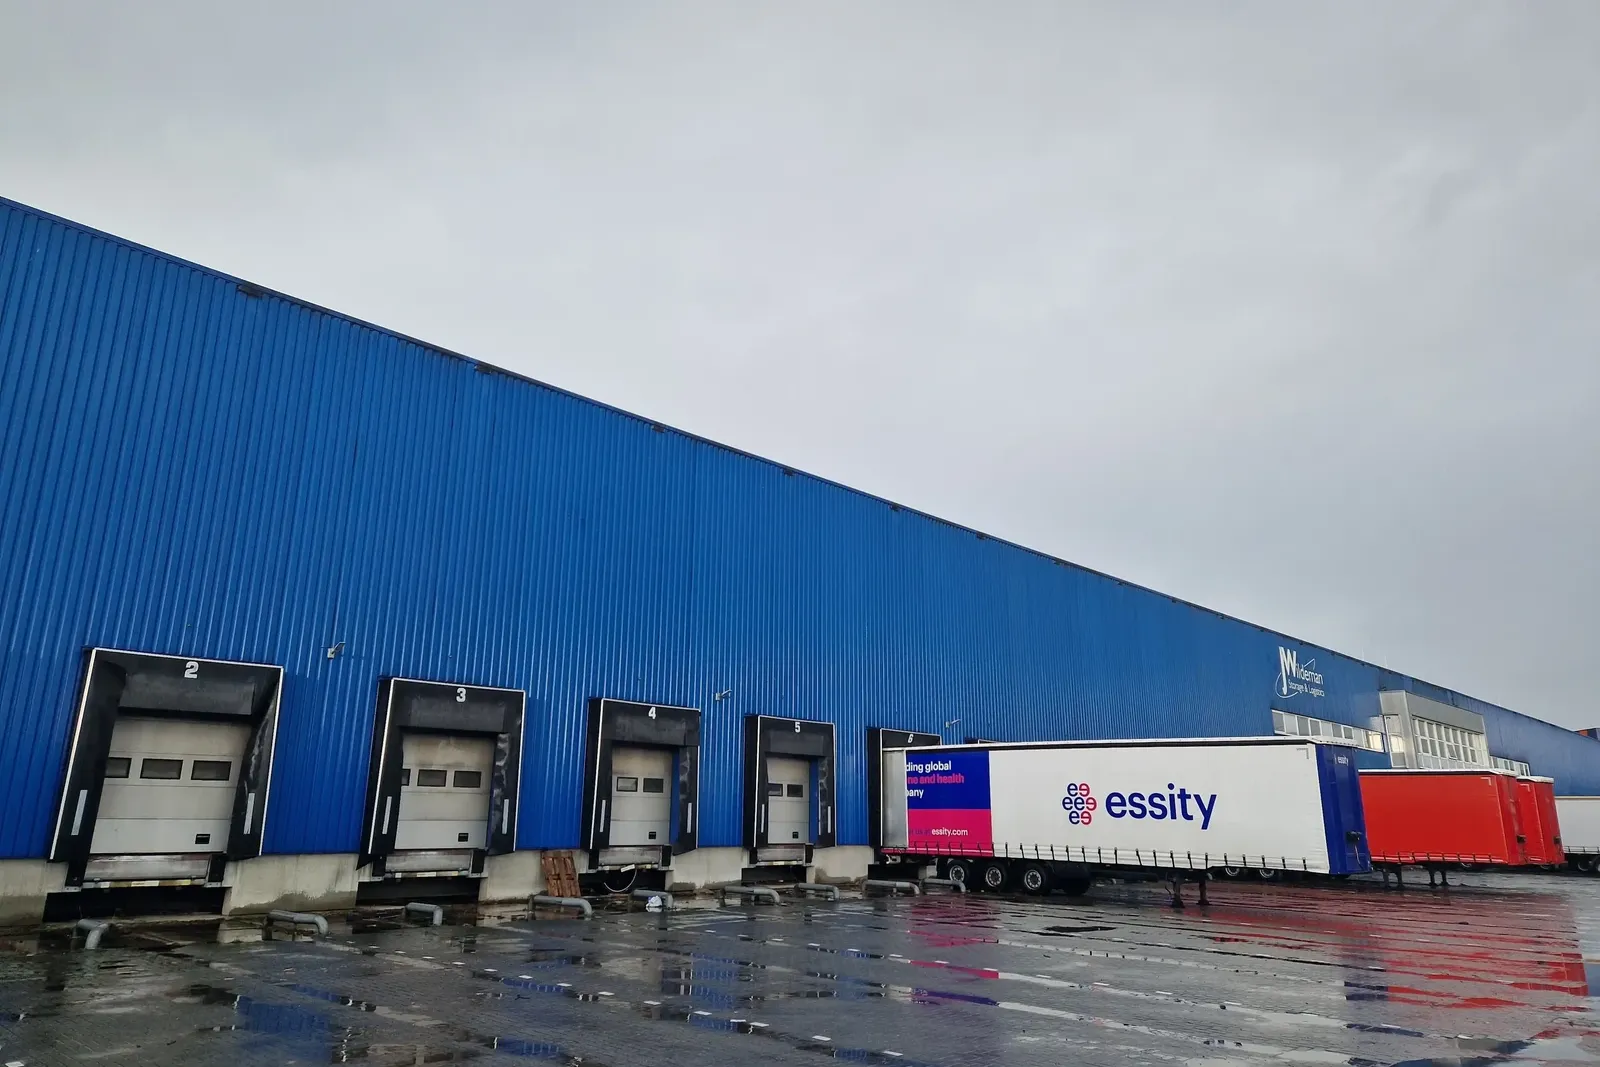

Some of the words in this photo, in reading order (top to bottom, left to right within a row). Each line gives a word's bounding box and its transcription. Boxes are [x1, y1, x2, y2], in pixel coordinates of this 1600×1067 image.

[184, 661, 199, 679] 2
[1279, 646, 1324, 695] Wildeman
[456, 687, 467, 703] 3
[648, 706, 657, 720] 4
[794, 721, 801, 733] 5
[907, 733, 914, 744] 6
[925, 760, 952, 773] global
[919, 774, 936, 784] and
[936, 773, 965, 784] health
[1105, 783, 1217, 830] essity
[931, 827, 969, 837] essity.com
